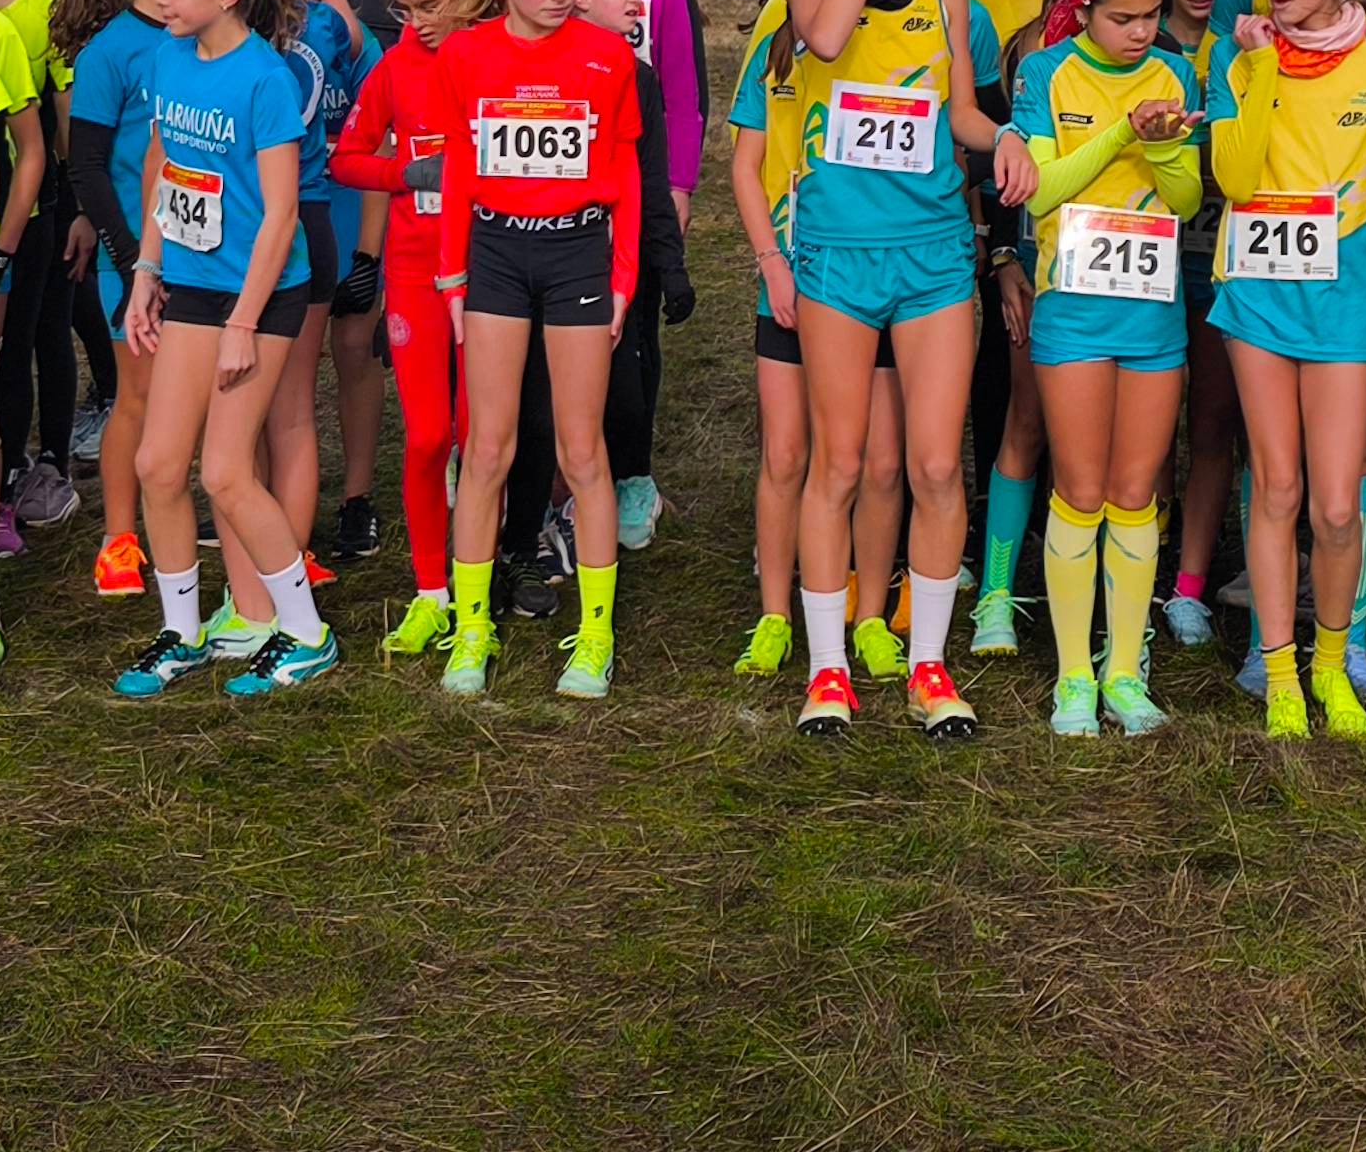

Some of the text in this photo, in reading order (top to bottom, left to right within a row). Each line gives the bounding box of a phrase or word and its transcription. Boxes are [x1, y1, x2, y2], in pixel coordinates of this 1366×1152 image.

[164, 101, 236, 145] ARMUÑA
[492, 124, 583, 159] 1063
[856, 117, 916, 152] 213
[169, 188, 209, 229] 434
[504, 213, 577, 232] NIKE
[1088, 236, 1160, 277] 215
[1248, 220, 1319, 257] 216
